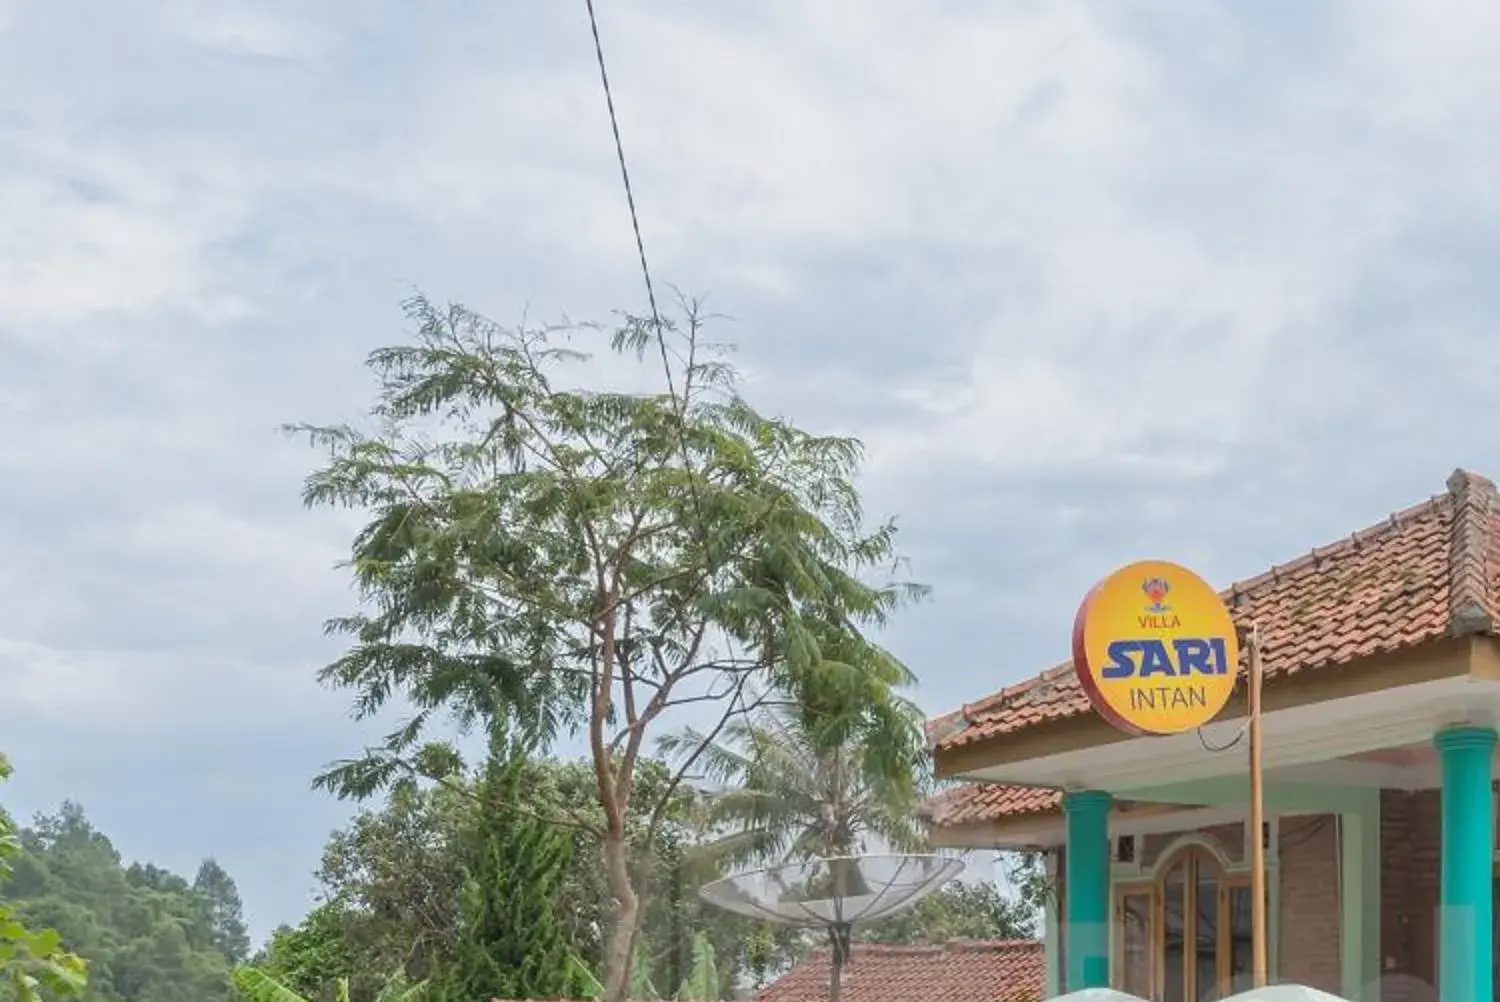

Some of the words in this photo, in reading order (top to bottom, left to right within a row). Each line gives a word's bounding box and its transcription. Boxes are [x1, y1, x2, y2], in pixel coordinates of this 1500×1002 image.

[1138, 615, 1181, 629] VILLA
[1102, 638, 1227, 678] SARI
[1130, 687, 1207, 711] INTAN
